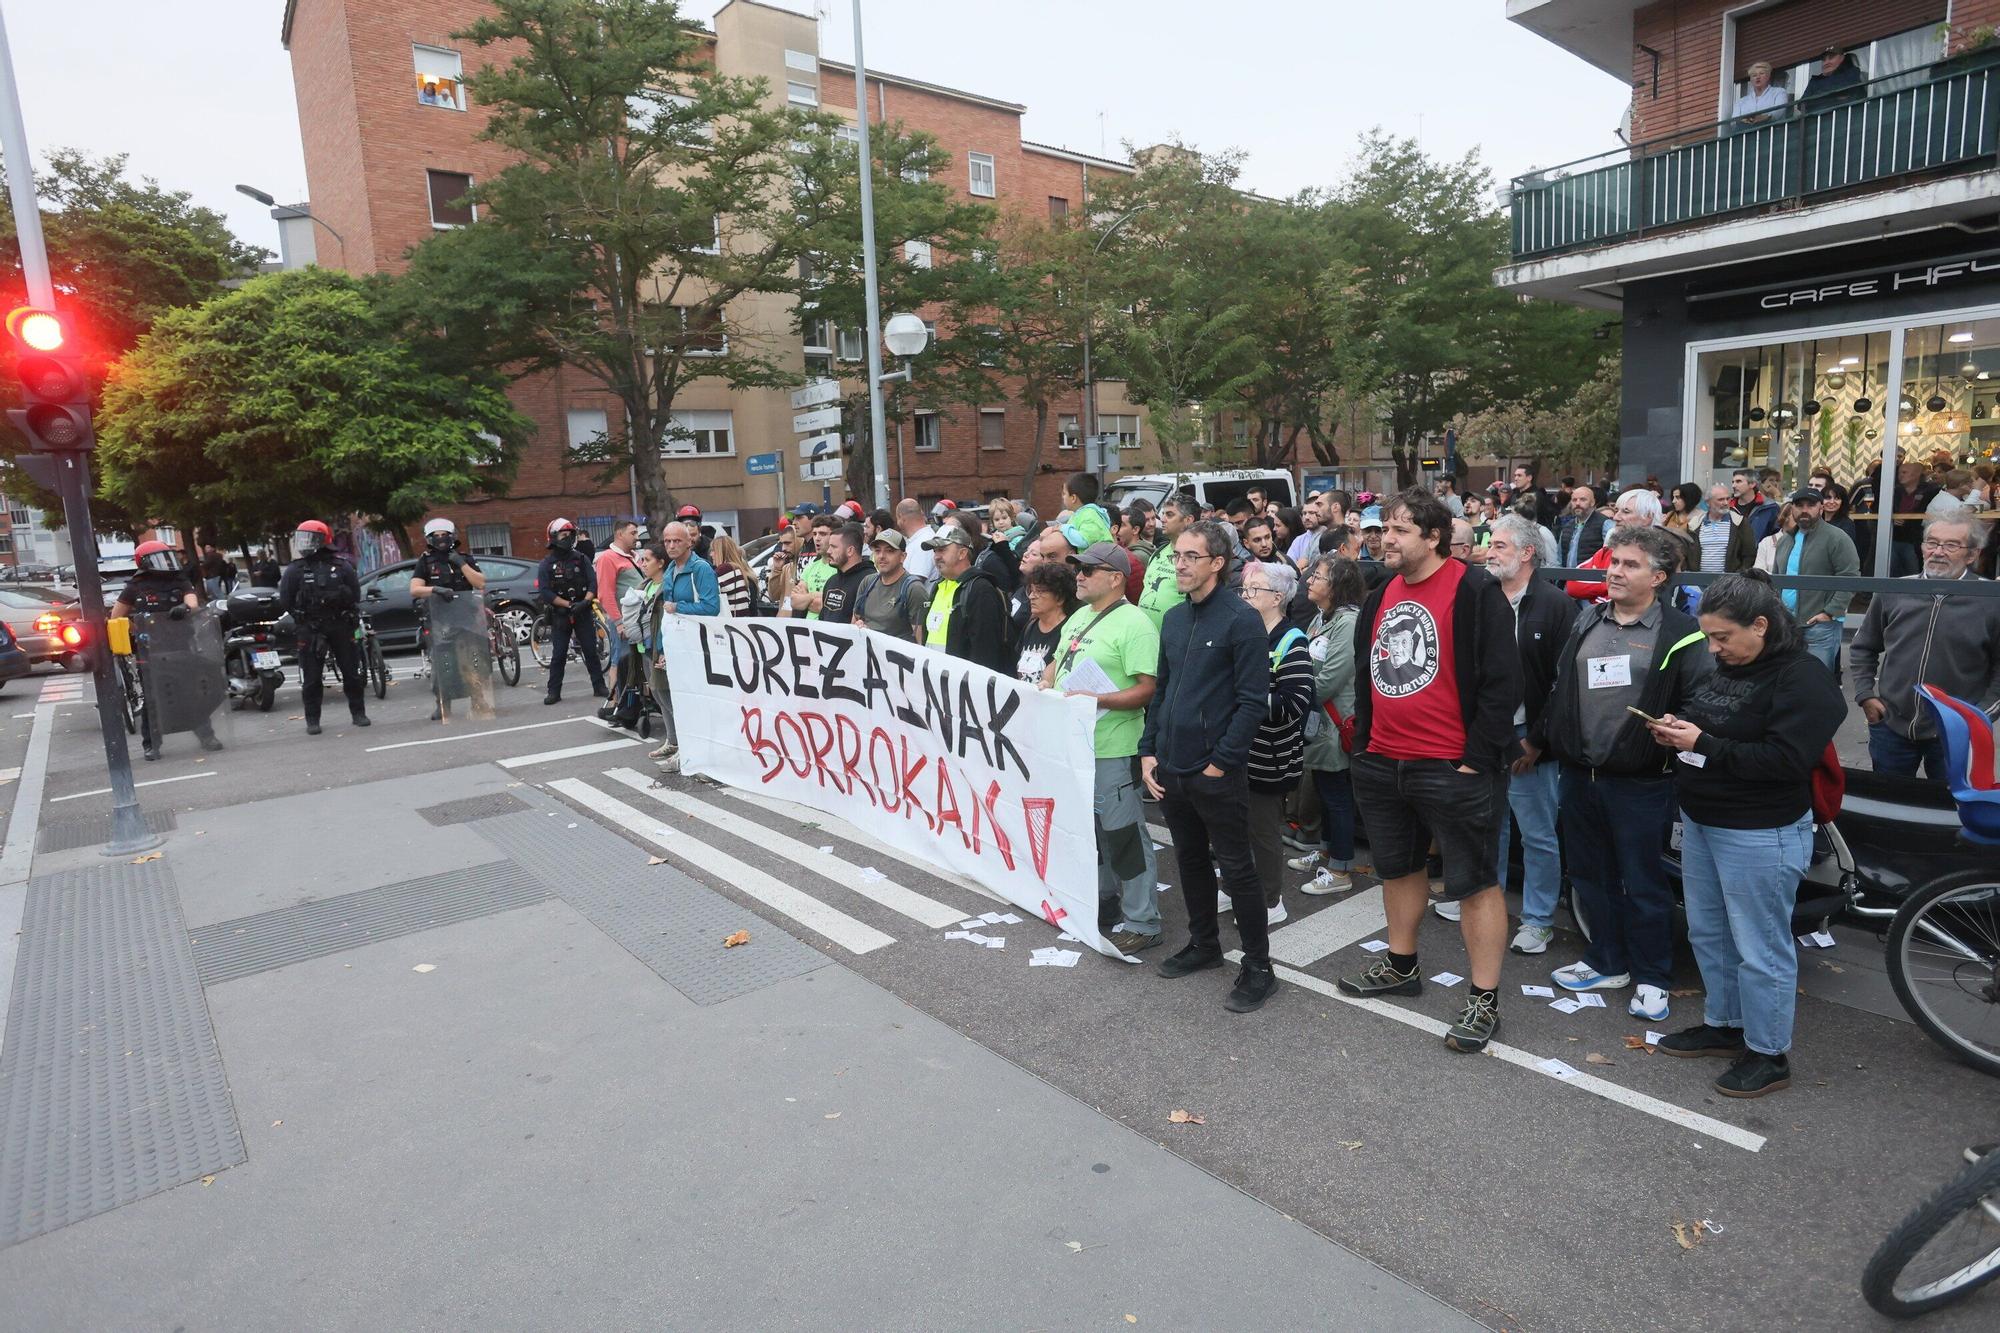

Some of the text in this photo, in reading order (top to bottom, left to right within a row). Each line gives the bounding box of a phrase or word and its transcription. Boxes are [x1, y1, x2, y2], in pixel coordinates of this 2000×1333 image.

[1760, 280, 1879, 309] CAFE
[1418, 613, 1435, 642] RUBIAS
[1375, 674, 1398, 695] LUCIOS
[1398, 660, 1436, 695] URTUBIAS
[699, 621, 1031, 783] LOREZAINAK
